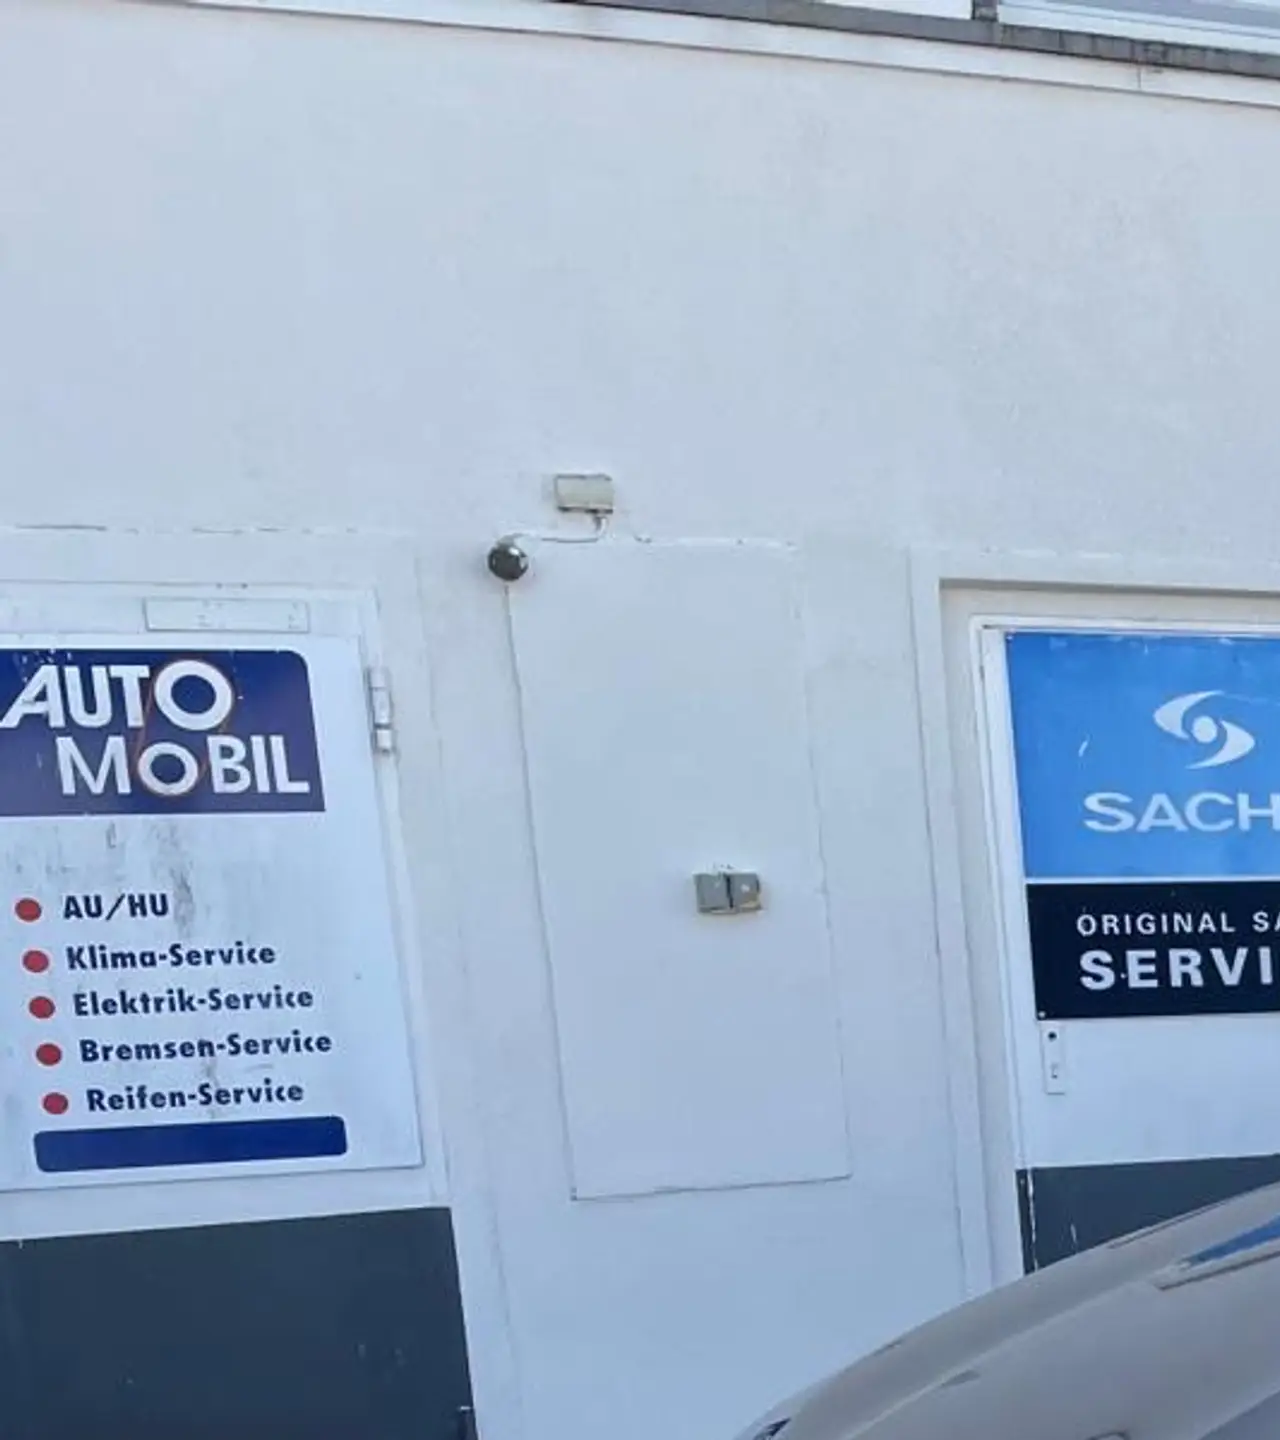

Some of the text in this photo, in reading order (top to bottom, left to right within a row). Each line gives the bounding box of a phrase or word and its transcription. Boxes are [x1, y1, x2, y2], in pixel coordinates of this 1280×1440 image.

[0, 660, 232, 730] AUTO
[55, 734, 309, 796] MOBIL
[63, 894, 169, 920] AU/HU
[1077, 912, 1235, 936] ORIGINAL
[66, 943, 276, 971] Klima-Service
[73, 985, 313, 1017] Elektrik-Service
[80, 1030, 332, 1064] Bremsen-Service
[87, 1082, 304, 1114] Reifen-Service
